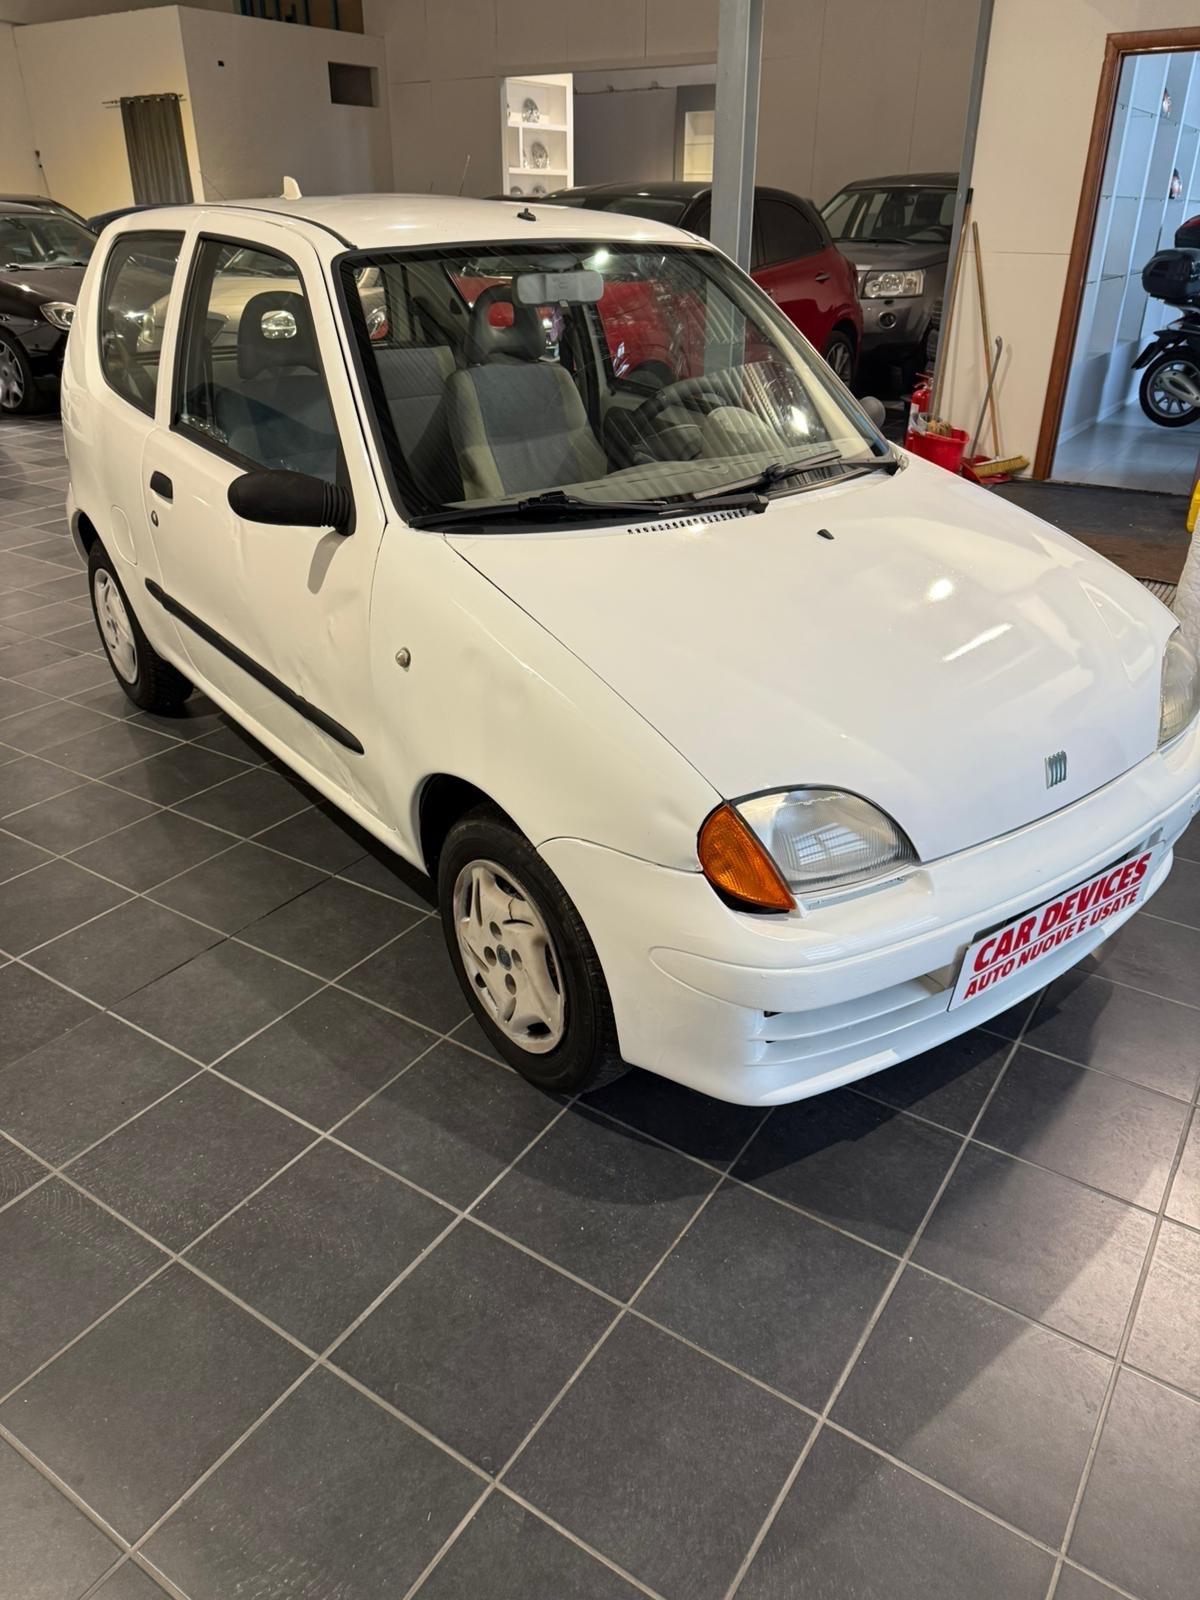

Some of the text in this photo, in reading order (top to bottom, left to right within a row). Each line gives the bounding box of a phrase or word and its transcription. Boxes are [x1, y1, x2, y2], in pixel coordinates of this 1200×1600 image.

[964, 887, 1140, 999] AUTO NUOVE E USATE
[973, 853, 1151, 973] CAR DEVICES
